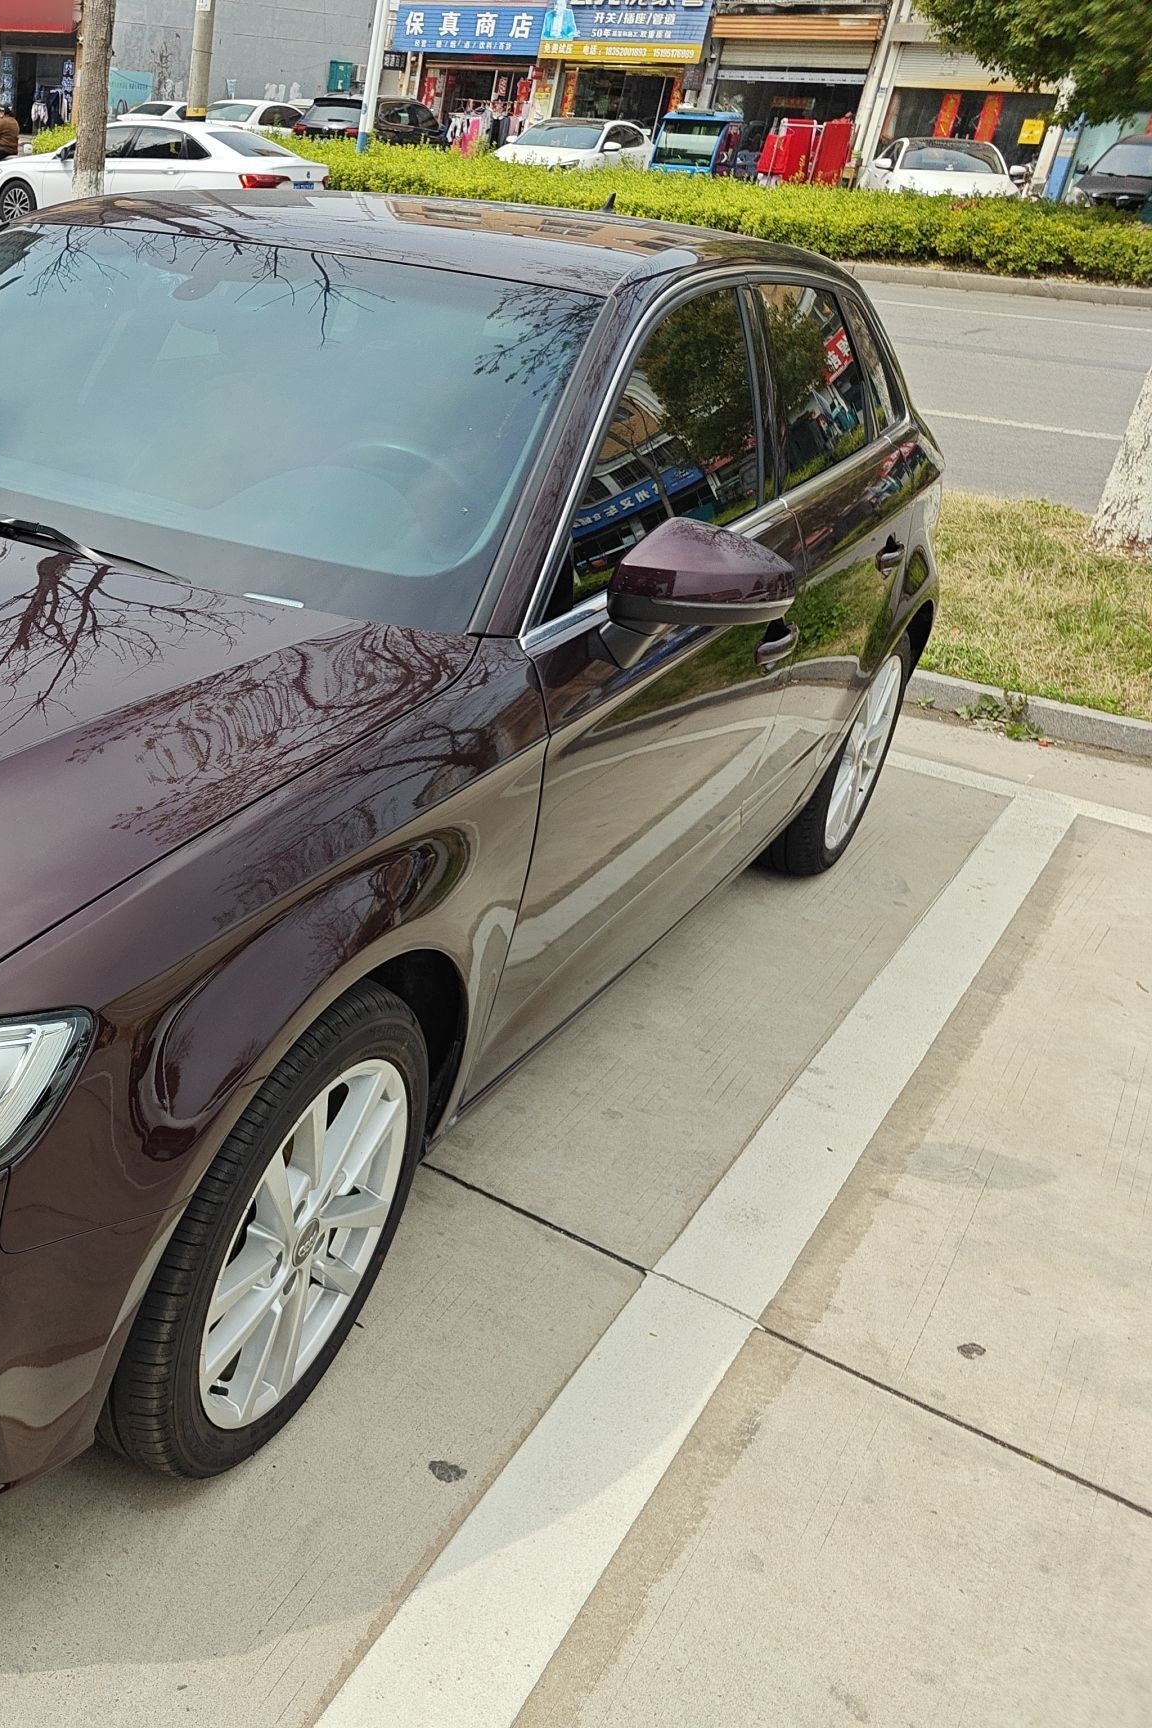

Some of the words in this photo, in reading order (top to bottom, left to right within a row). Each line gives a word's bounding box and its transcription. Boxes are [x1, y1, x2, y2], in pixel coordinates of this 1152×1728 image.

[405, 11, 534, 39] 保真商店
[594, 12, 676, 26] 开关/插座/管道
[544, 43, 574, 54] 免费试压
